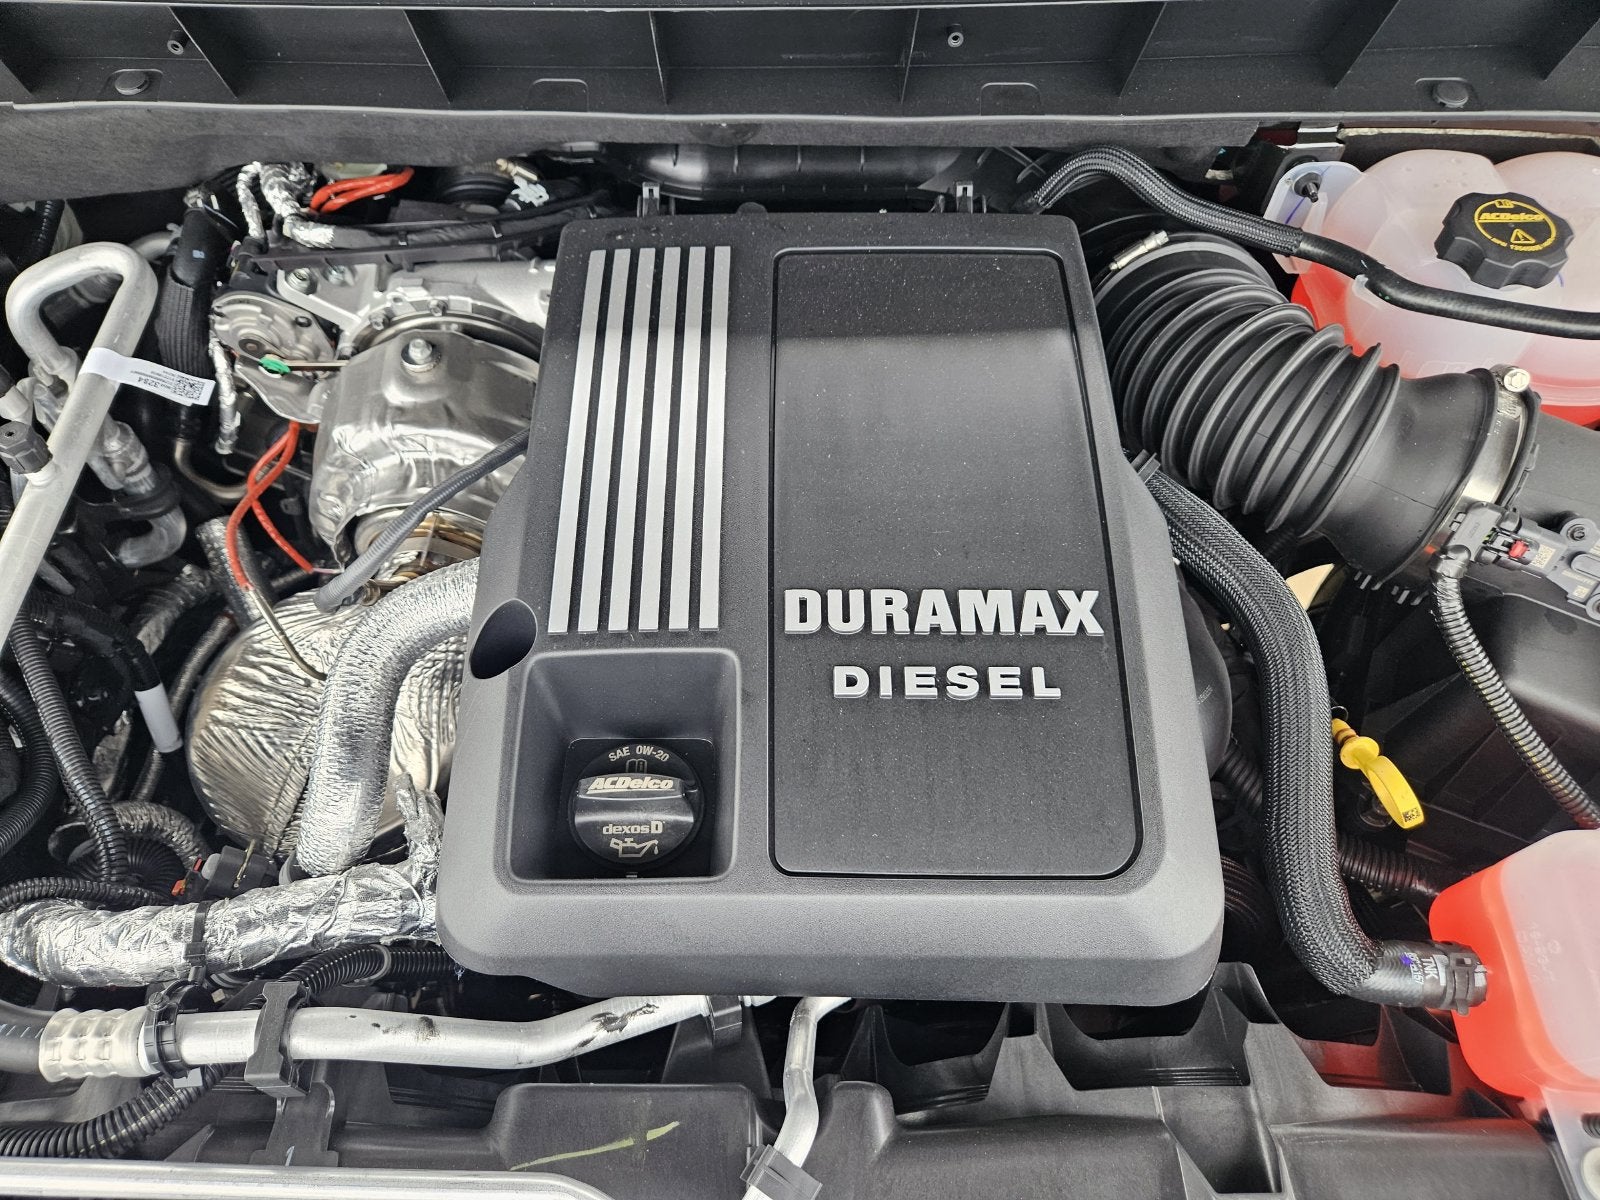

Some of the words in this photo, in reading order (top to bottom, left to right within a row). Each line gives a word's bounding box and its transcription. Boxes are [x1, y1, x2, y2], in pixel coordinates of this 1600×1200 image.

[784, 589, 1104, 636] DURAMAX
[833, 665, 1061, 700] DIESEL
[608, 746, 630, 762] SAE
[636, 745, 670, 762] 0W-20
[588, 776, 674, 790] ACDelco
[1421, 956, 1439, 980] TNK
